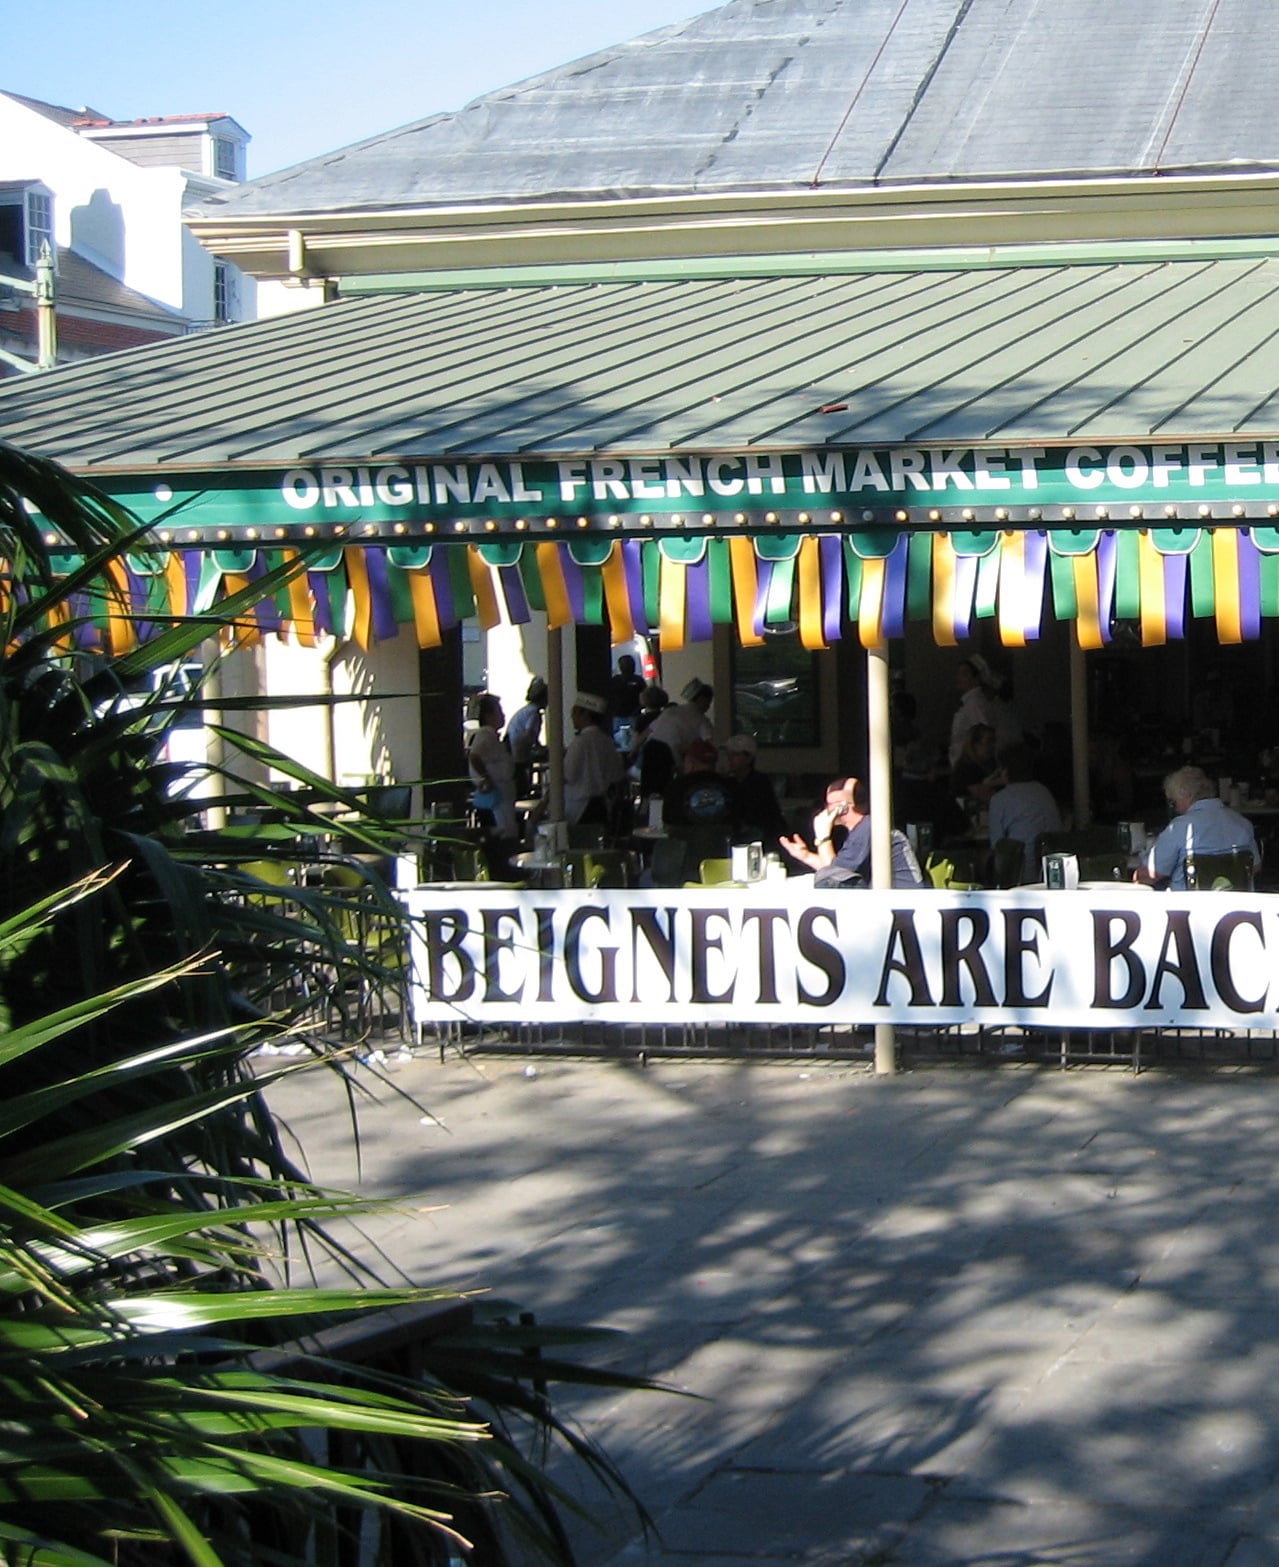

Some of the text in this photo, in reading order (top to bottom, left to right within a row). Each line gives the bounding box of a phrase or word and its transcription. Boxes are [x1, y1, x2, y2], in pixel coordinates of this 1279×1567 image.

[282, 462, 543, 509] ORIGINAL
[559, 454, 785, 502] FRENCH
[801, 447, 1046, 494] MARKET
[423, 904, 847, 1007] BEIGNETS
[872, 907, 1056, 1009] ARE
